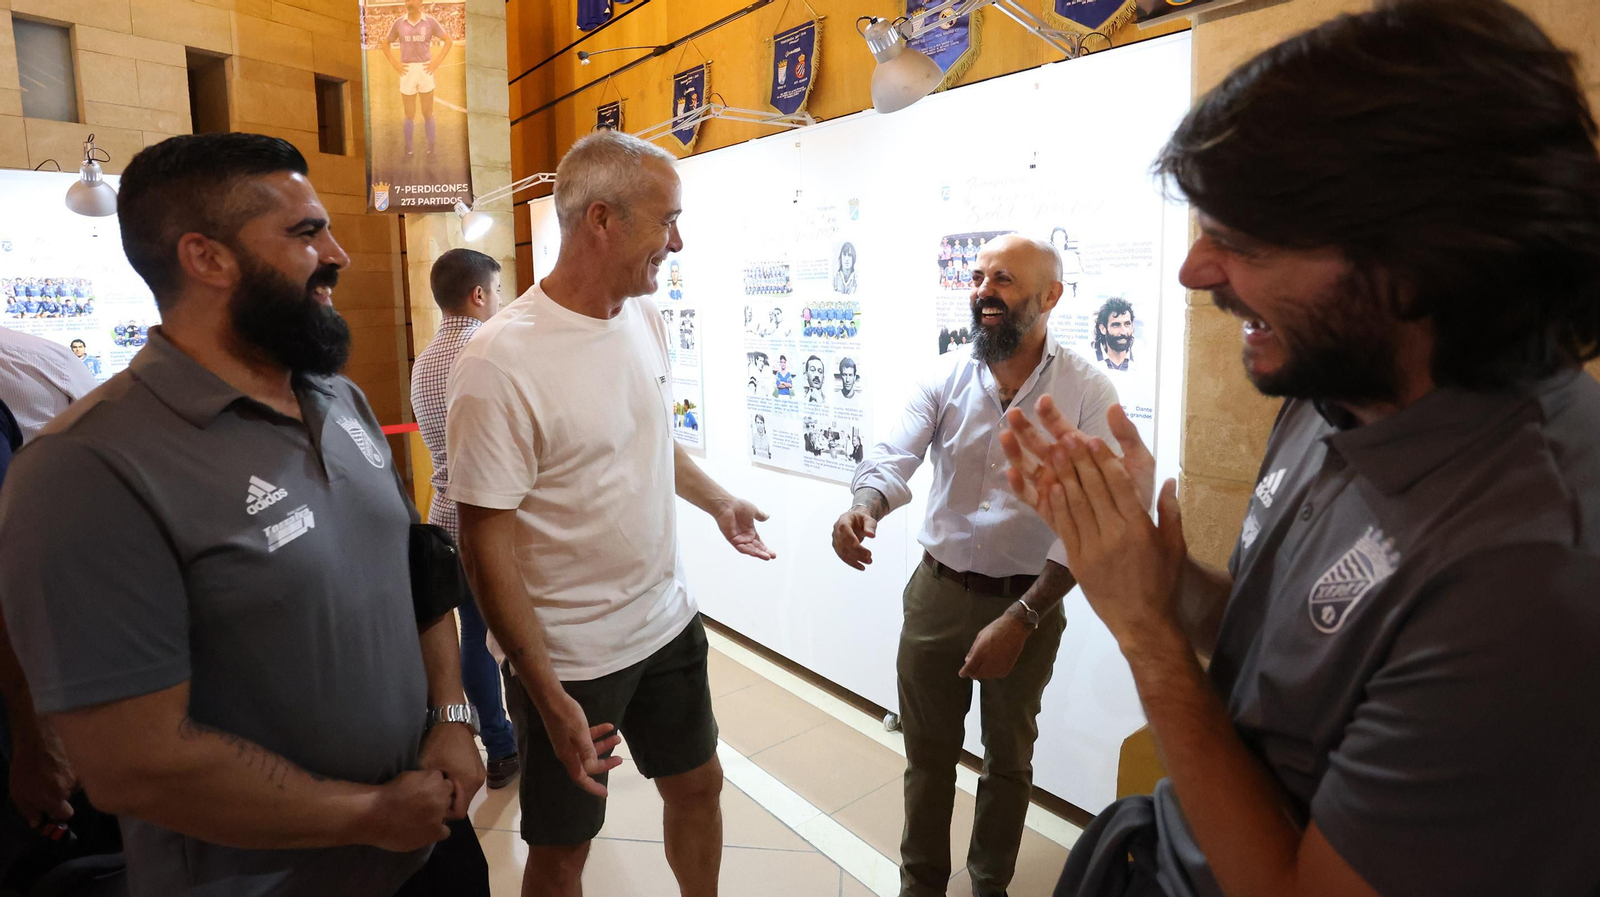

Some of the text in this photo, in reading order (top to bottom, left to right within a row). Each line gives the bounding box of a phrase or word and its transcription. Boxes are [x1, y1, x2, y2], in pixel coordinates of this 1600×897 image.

[395, 184, 468, 194] 7-PERDIGONES
[418, 197, 462, 205] PARTIDOS
[246, 488, 288, 515] adidas
